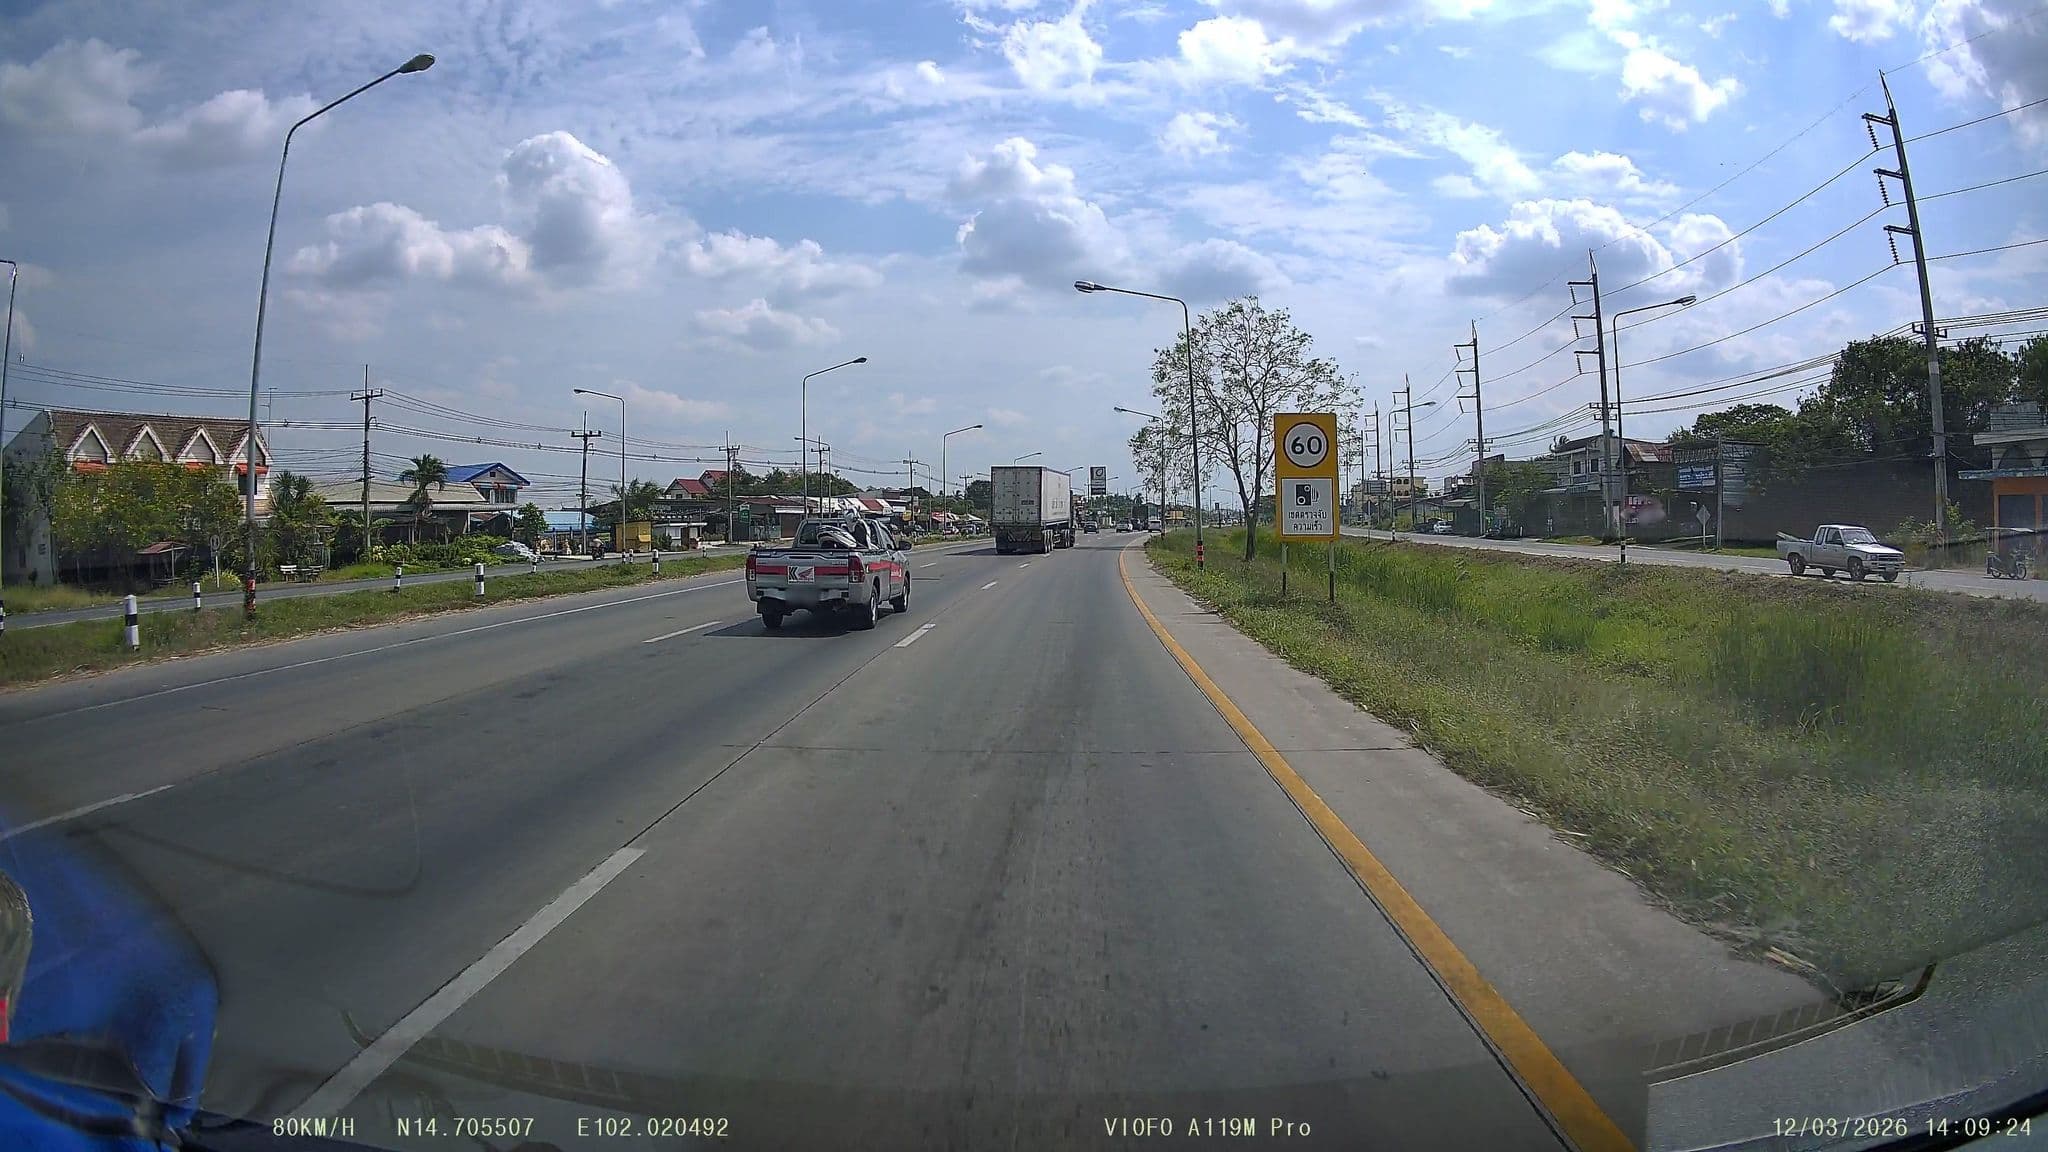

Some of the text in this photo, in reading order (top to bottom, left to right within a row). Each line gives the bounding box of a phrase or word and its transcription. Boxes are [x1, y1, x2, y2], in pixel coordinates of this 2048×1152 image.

[1291, 436, 1322, 455] 60
[1293, 520, 1323, 531] ความเร็ว
